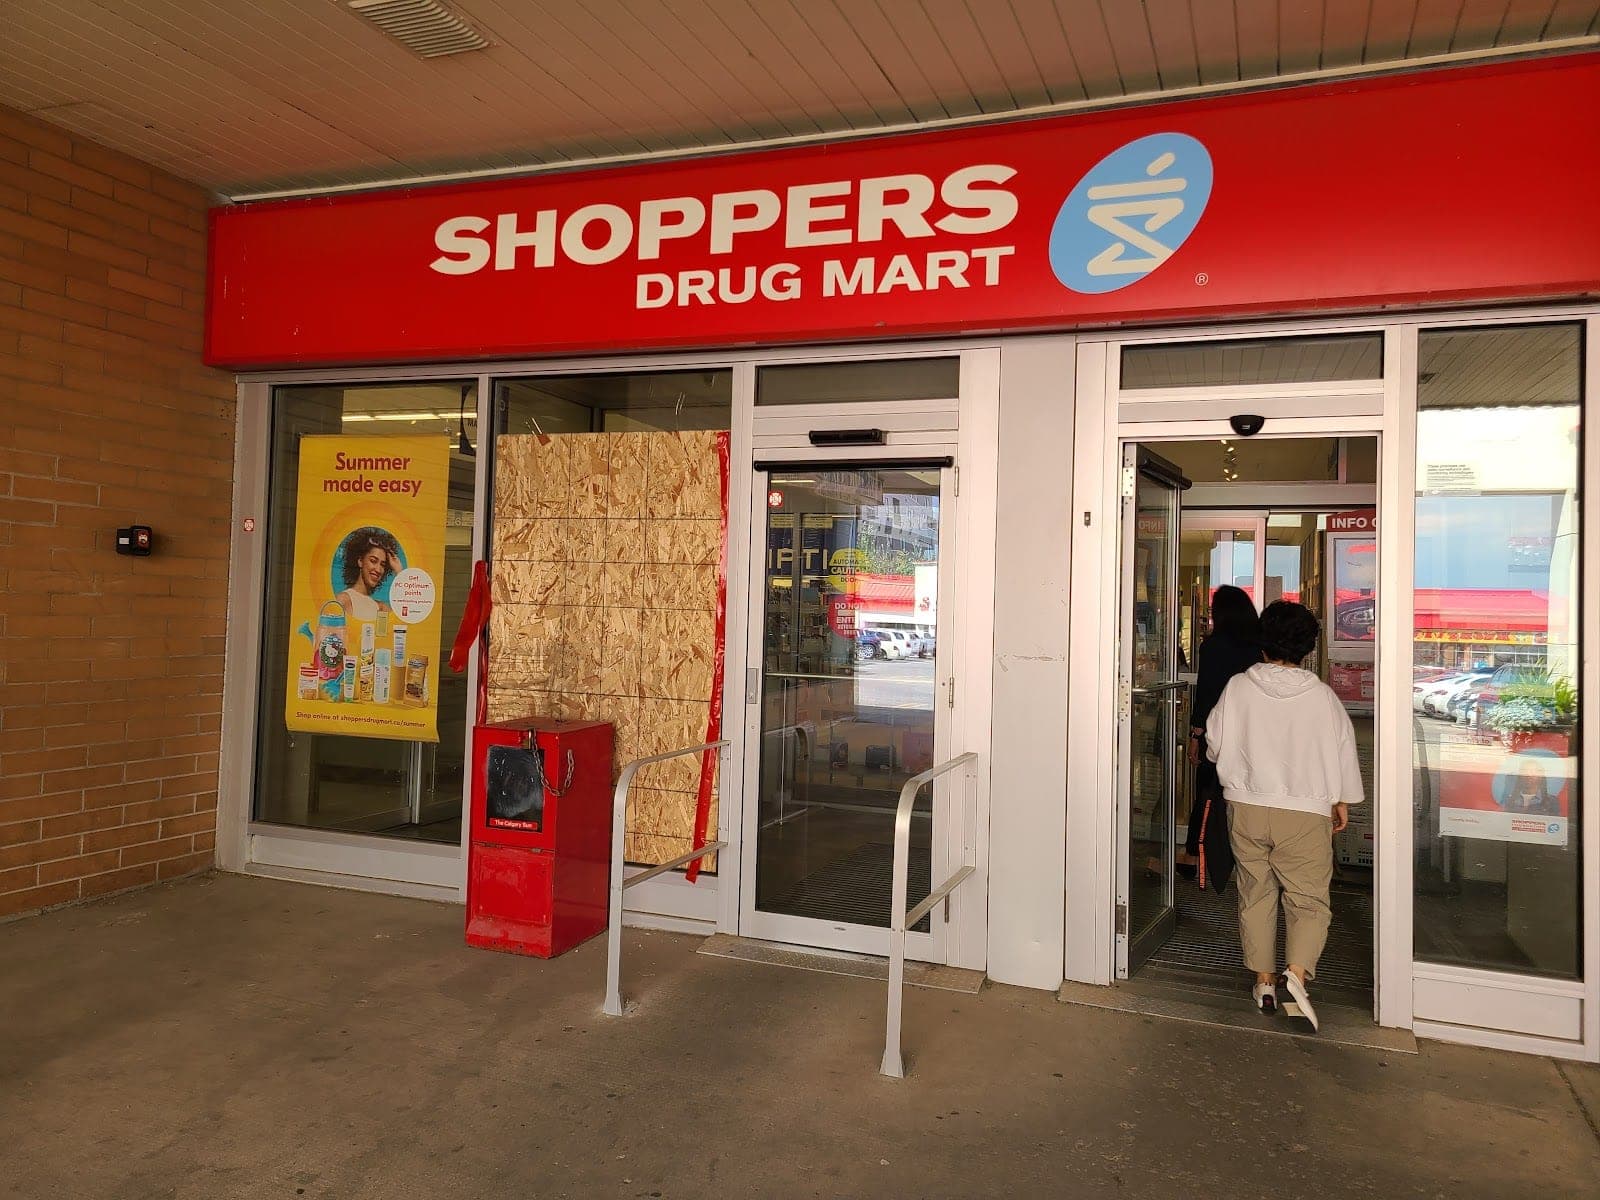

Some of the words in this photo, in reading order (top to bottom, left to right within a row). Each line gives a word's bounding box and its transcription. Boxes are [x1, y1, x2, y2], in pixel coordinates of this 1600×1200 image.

[429, 164, 1019, 275] SHOPPERS
[636, 263, 802, 309] DRUG
[822, 245, 1015, 297] MART
[335, 452, 411, 471] Summer
[323, 475, 374, 493] made
[378, 479, 422, 498] easy
[1331, 517, 1368, 529] INFO
[834, 602, 846, 610] DO
[295, 711, 311, 719] Shop
